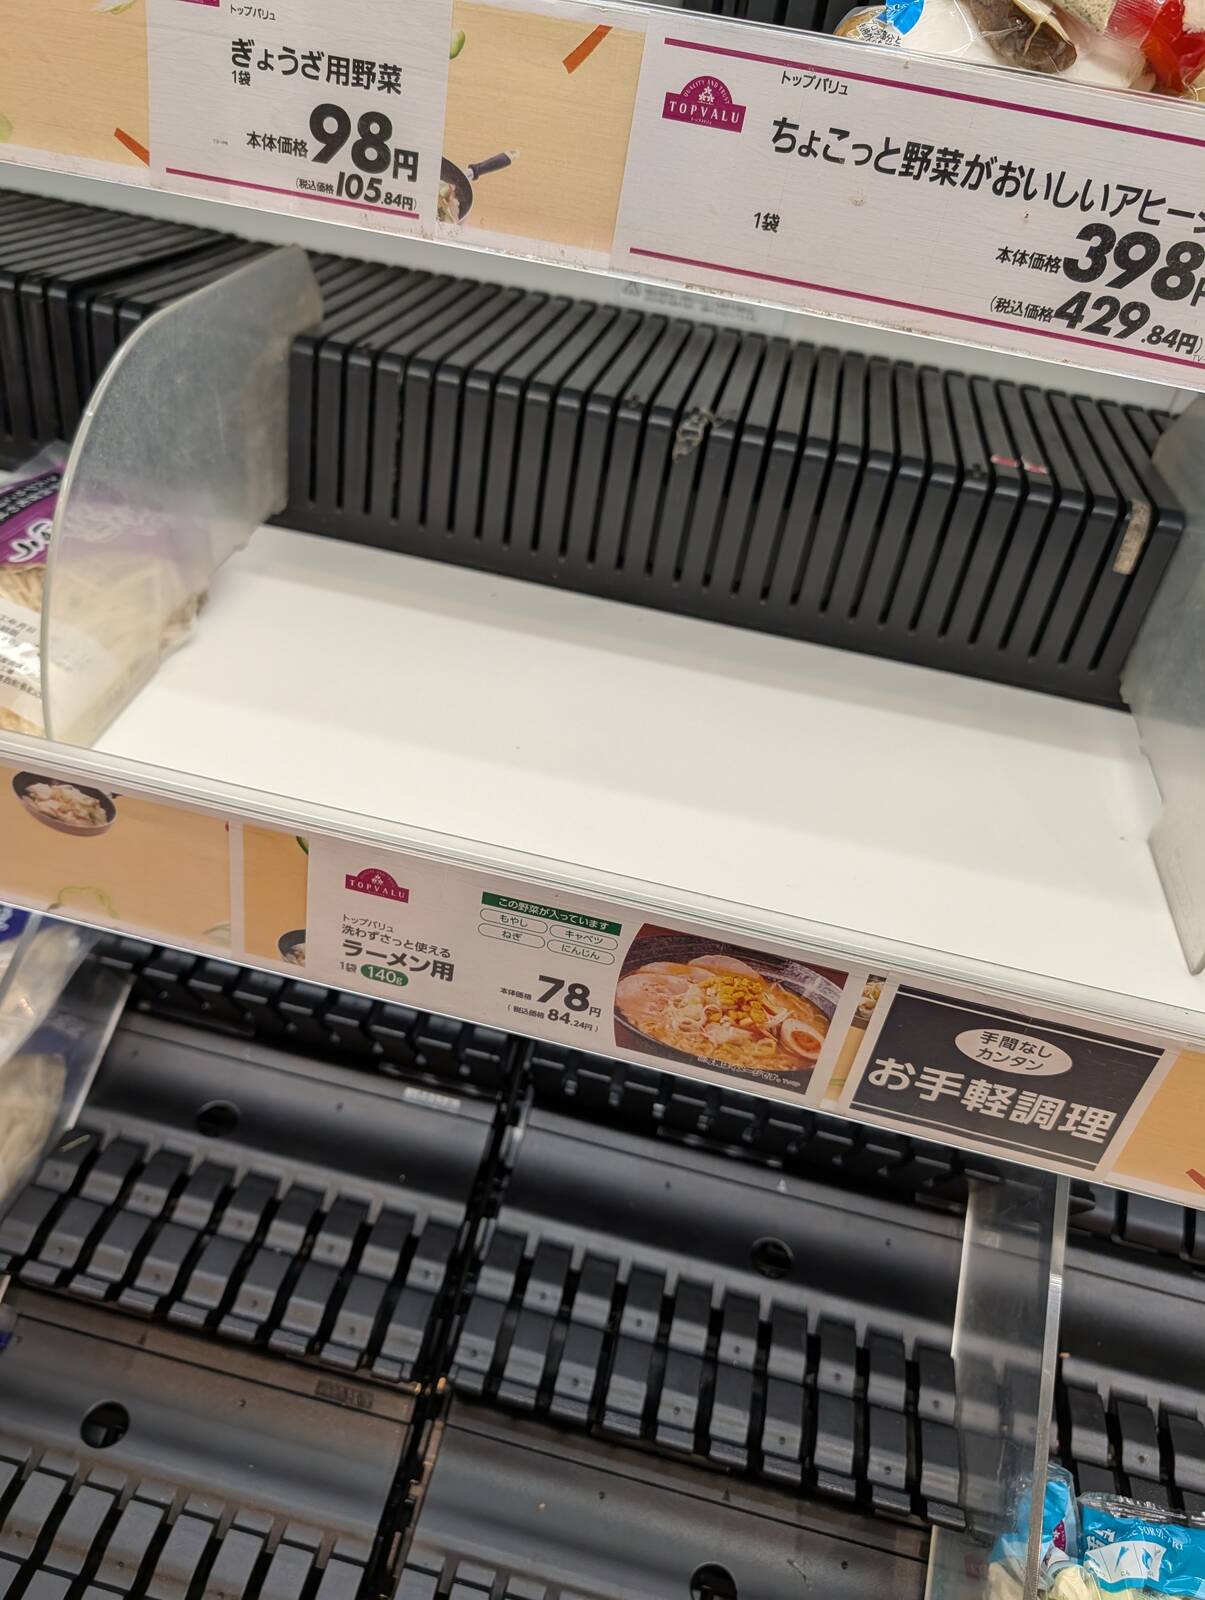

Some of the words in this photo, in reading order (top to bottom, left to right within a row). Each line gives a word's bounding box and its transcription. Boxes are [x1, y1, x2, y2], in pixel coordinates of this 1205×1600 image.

[229, 4, 276, 21] トップバリュ
[231, 38, 403, 96] ぎょうざ用野菜
[231, 70, 251, 87] 1袋
[780, 70, 848, 96] トップバリュ
[669, 100, 740, 124] TOPVALU
[753, 212, 780, 233] 1袋
[349, 878, 407, 899] TOPVALU
[341, 913, 394, 933] トップバリュ
[498, 898, 609, 931] この野菜が入っています
[499, 913, 528, 928] もやし
[341, 924, 451, 959] 洗わずさっと使える
[502, 929, 522, 942] ねぎ
[564, 928, 604, 945] キャベツ
[341, 939, 455, 983] ラーメン用
[560, 943, 600, 960] にんじん
[366, 965, 403, 986] 140g
[980, 1030, 1053, 1058] 手間なし
[974, 1047, 1045, 1072] カンタン
[868, 1056, 1118, 1144] お手軽調理
